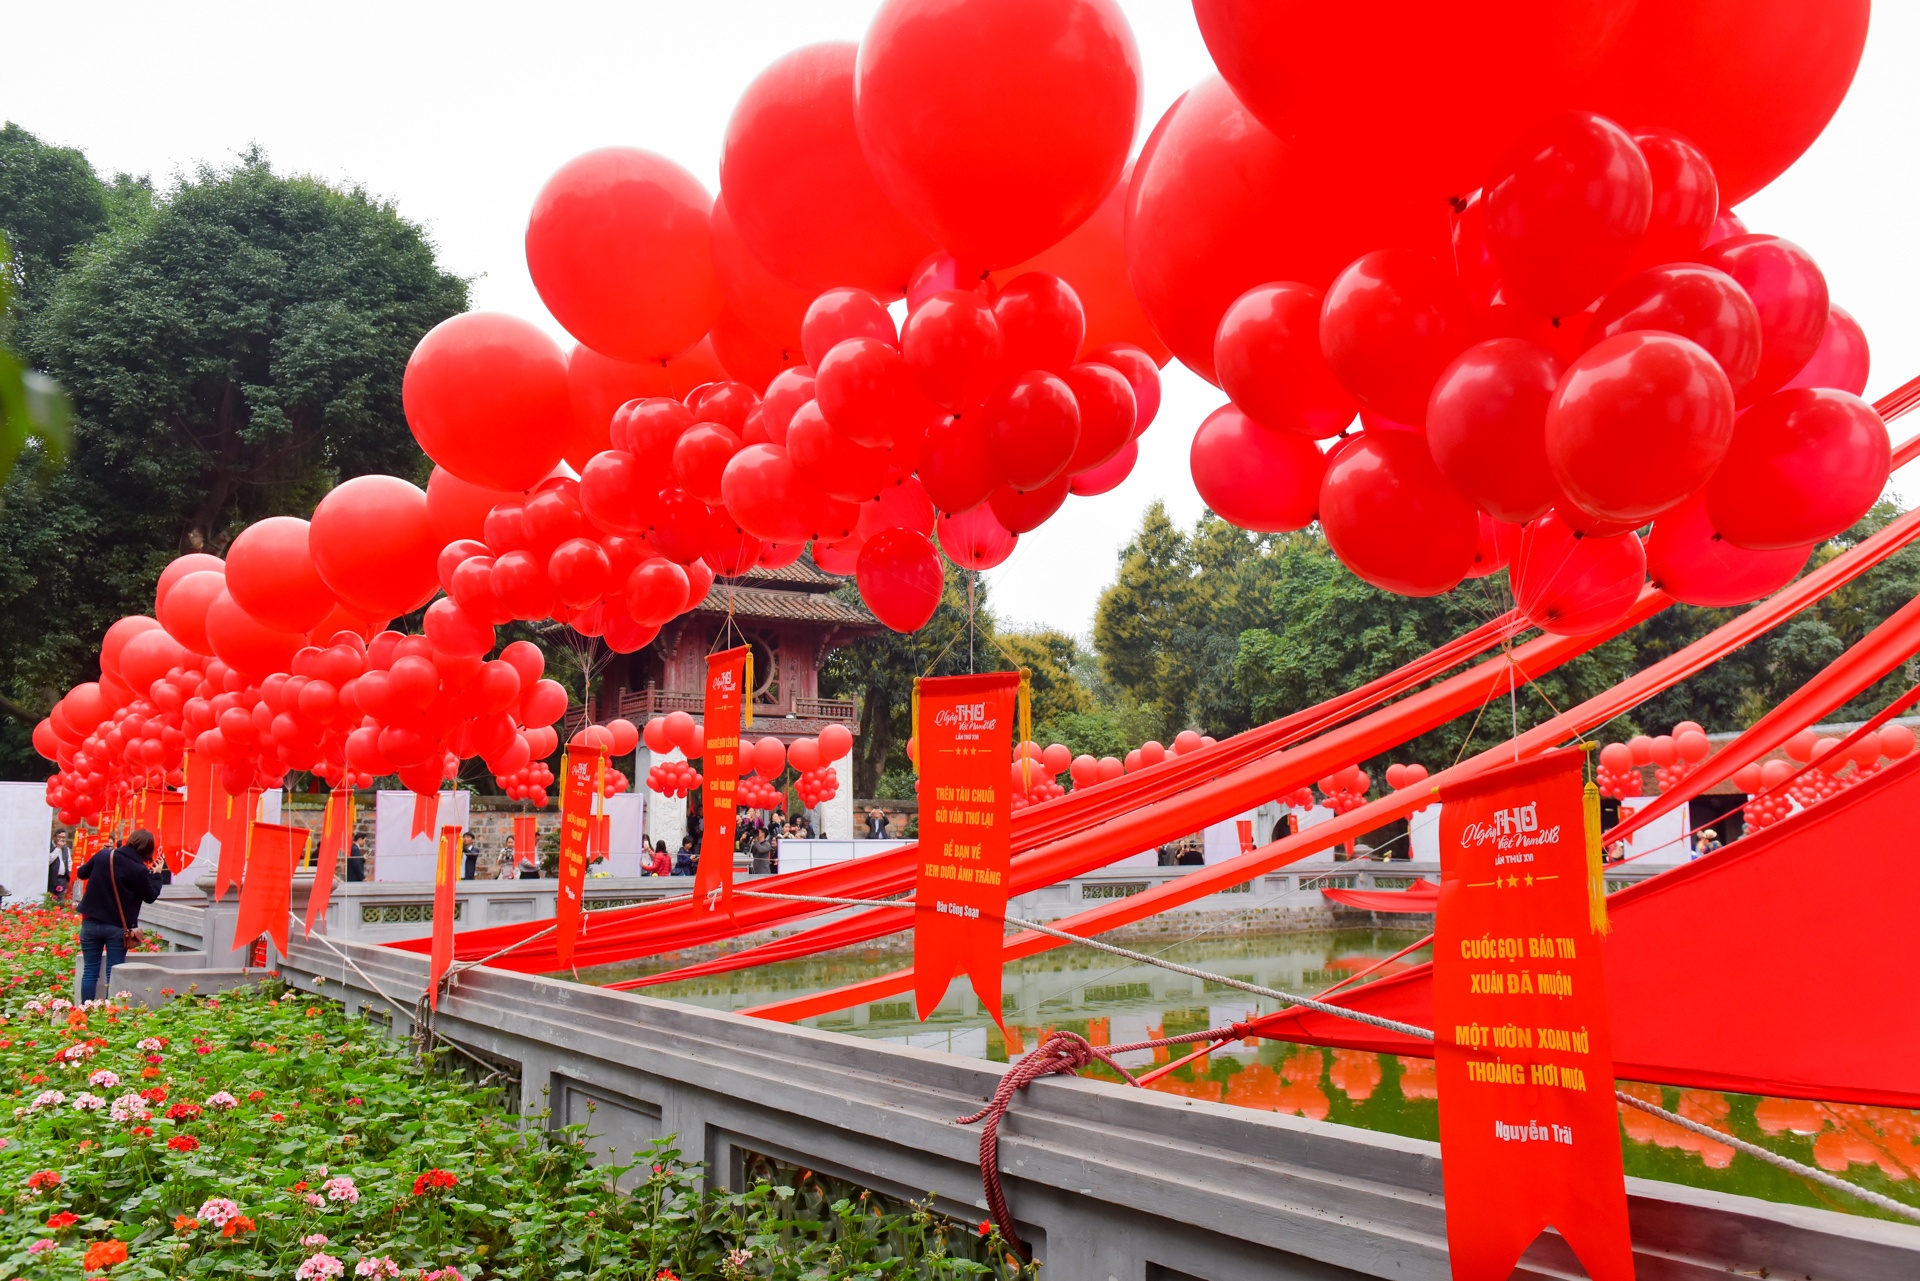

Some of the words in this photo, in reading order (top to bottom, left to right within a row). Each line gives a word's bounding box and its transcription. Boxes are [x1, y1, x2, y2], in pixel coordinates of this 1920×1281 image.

[934, 709, 958, 727] Ngày
[955, 702, 985, 721] THƠ
[936, 785, 954, 801] TRÊN
[956, 786, 970, 802] TÀU
[971, 785, 995, 803] CHUỐI
[965, 810, 981, 825] THƠ
[981, 812, 994, 829] LẠI
[1494, 801, 1538, 836] THƠ
[1460, 821, 1497, 848] Ngày
[1497, 835, 1514, 850] Việt
[1513, 832, 1541, 848] Nam
[1539, 825, 1560, 845] 2018
[954, 844, 970, 861] BẠN
[1494, 854, 1505, 866] LẦN
[1505, 852, 1523, 864] THỨ
[1523, 853, 1534, 862] XVI
[924, 863, 940, 878] XEM
[940, 864, 957, 880] DƯỚI
[957, 865, 974, 882] ÁNH
[975, 867, 1002, 885] TRĂNG
[936, 900, 948, 913] Đào
[948, 902, 964, 917] Công
[964, 905, 980, 920] Soạn
[1461, 932, 1497, 959] CUỐC
[1498, 938, 1524, 962] GỌI
[1528, 933, 1555, 958] BÁO
[1555, 938, 1577, 959] TIN
[1470, 970, 1504, 994] XUÂN
[1507, 969, 1534, 994] ĐÃ
[1537, 970, 1573, 1001] MUỘN
[1455, 1022, 1489, 1050] MỘT
[1492, 1022, 1533, 1049] VƯỜN
[1537, 1028, 1572, 1052] XOAN
[1571, 1025, 1590, 1055] NỞ
[1466, 1056, 1526, 1085] THOẢNG
[1530, 1063, 1559, 1087] HƠI
[1560, 1066, 1587, 1092] MƯA
[1495, 1119, 1550, 1143] Nguyễn
[1551, 1123, 1573, 1145] Trãi
